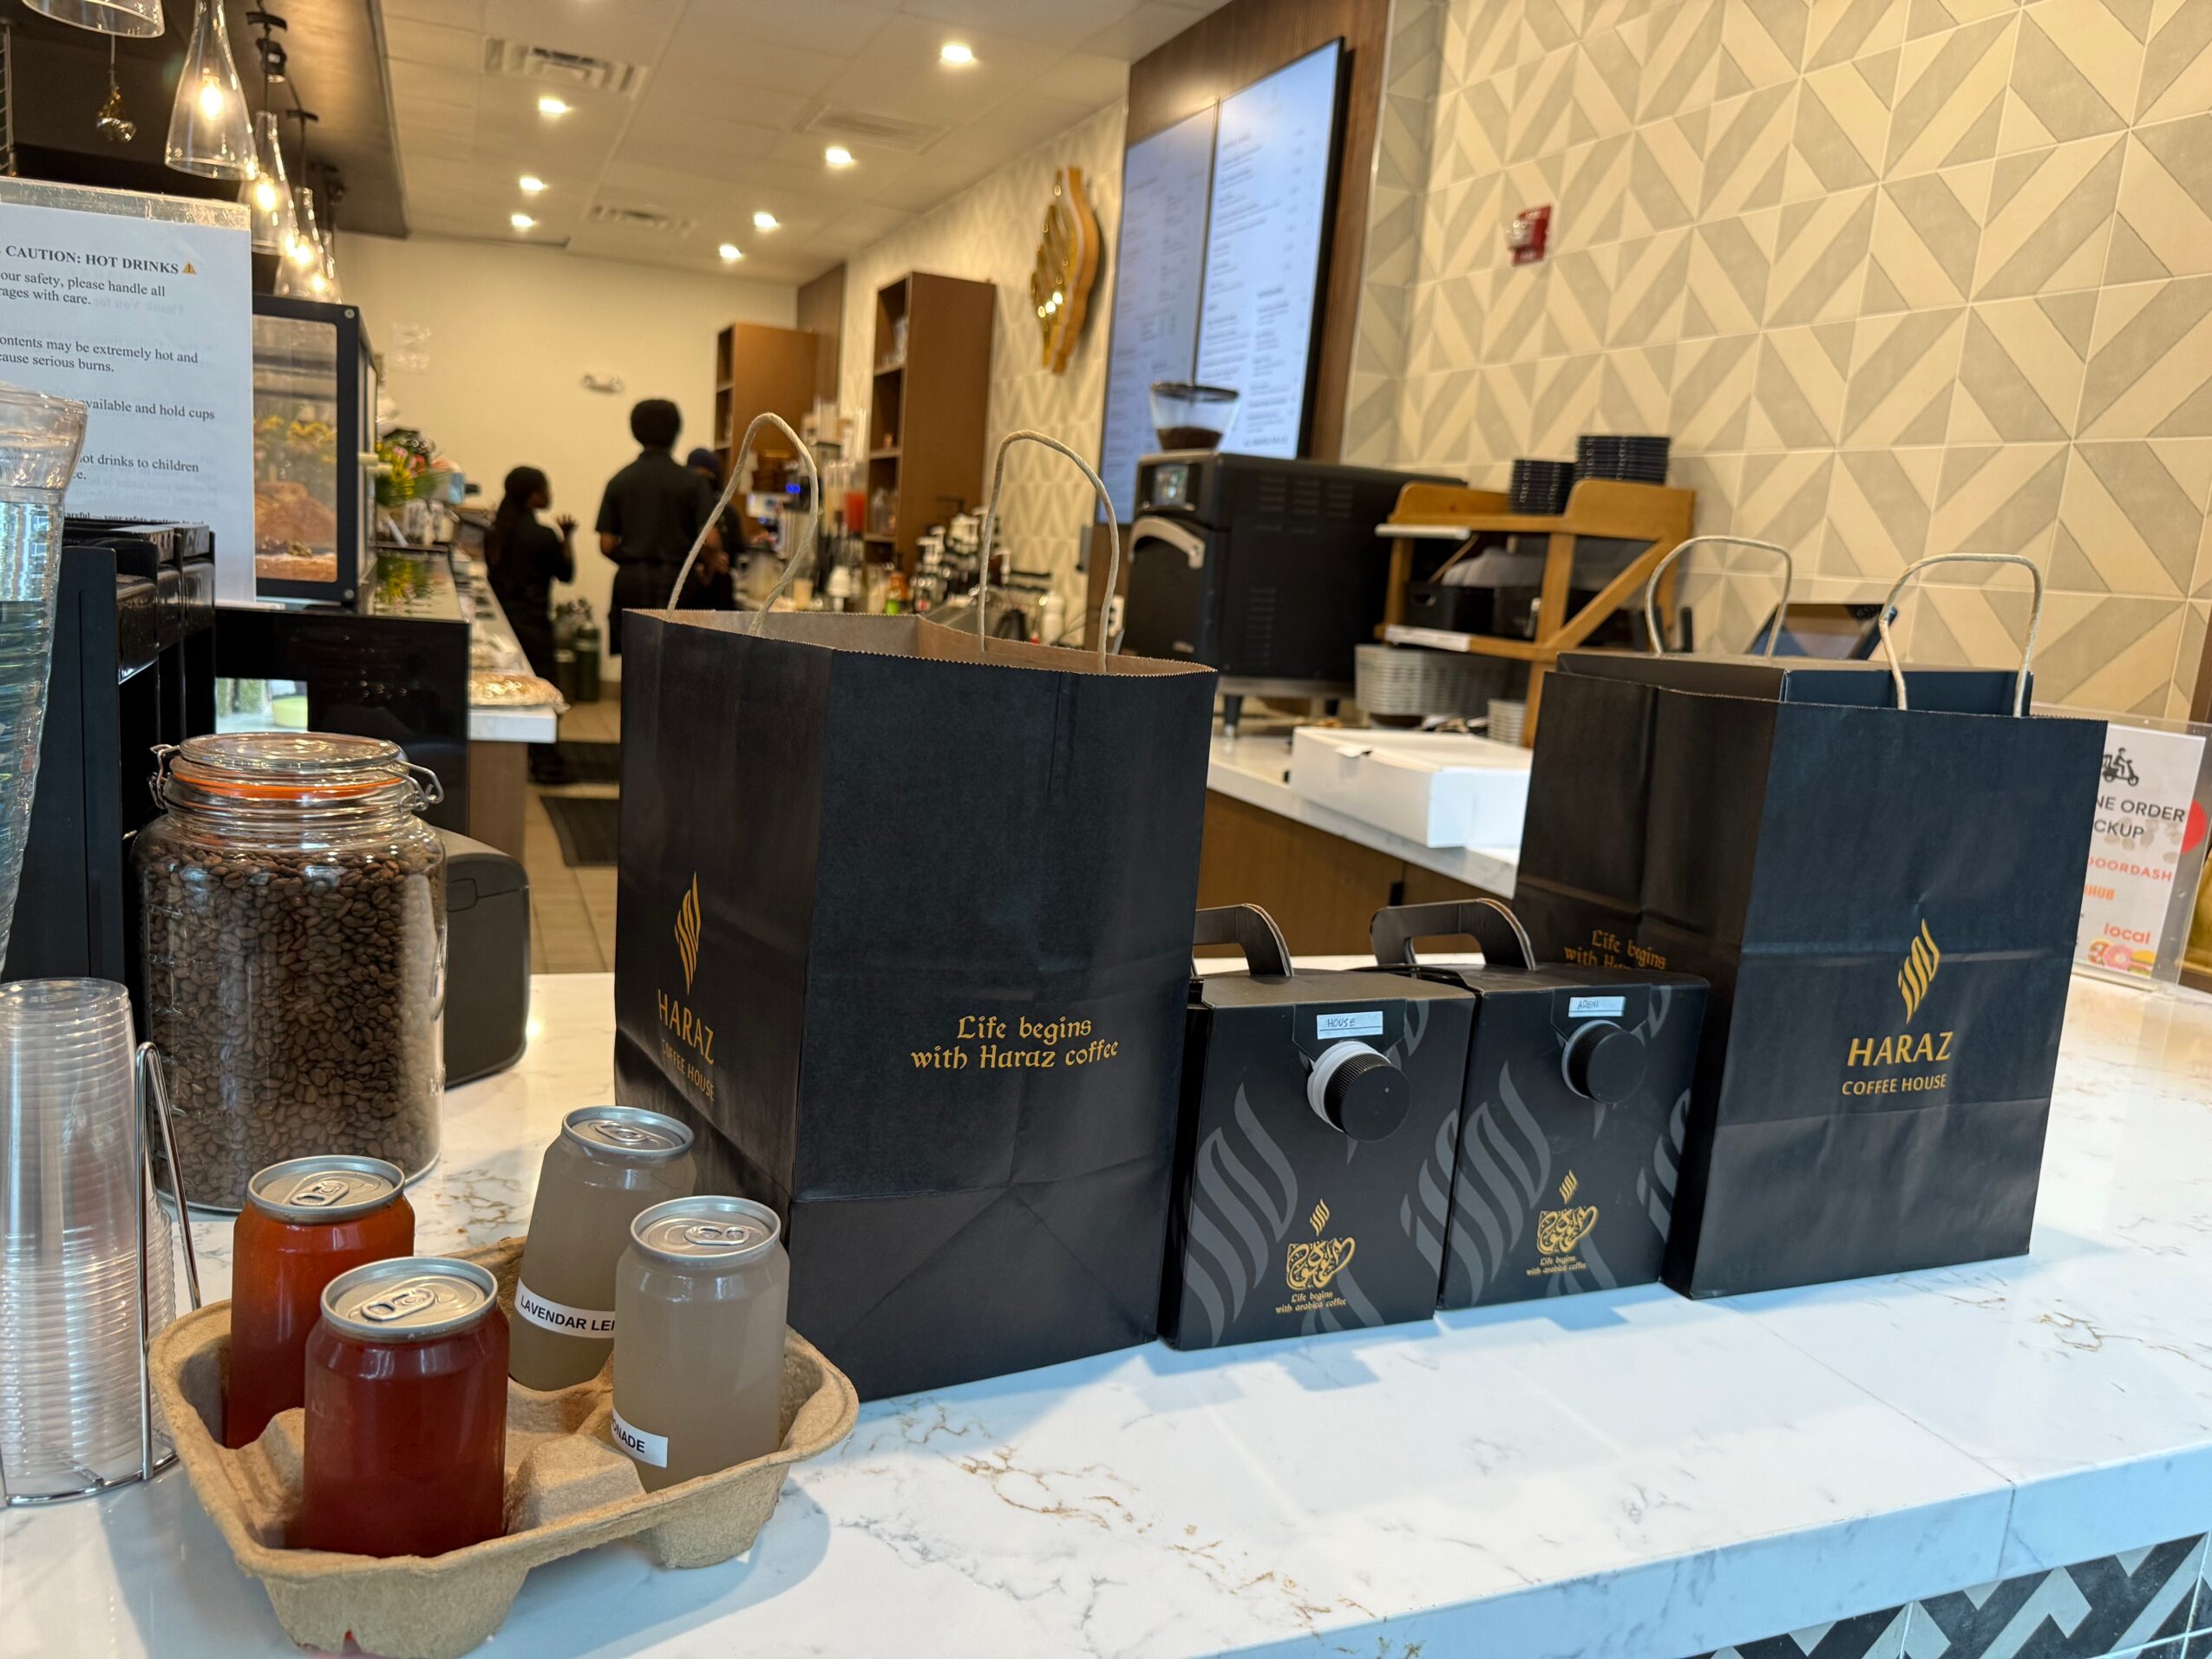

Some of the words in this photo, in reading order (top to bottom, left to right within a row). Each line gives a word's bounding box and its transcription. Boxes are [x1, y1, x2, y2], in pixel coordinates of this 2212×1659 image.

[5, 245, 82, 264] CAUTION:
[86, 254, 118, 268] HOT
[122, 258, 179, 274] DRINKS
[0, 271, 22, 281] our
[24, 272, 64, 288] safety,
[68, 277, 104, 291] please
[108, 280, 147, 295] handle
[151, 285, 166, 297] all
[33, 289, 59, 302] with
[62, 294, 91, 304] care.
[0, 336, 43, 348] ontents
[46, 342, 72, 353] may
[75, 341, 89, 353] be
[93, 344, 152, 361] extremely
[155, 349, 174, 362] hot
[177, 353, 199, 363] and
[32, 356, 75, 369] serious
[78, 358, 115, 372] burns.
[135, 403, 156, 415] and
[160, 404, 185, 417] hold
[189, 408, 215, 421] cups
[98, 454, 134, 467] drinks
[137, 460, 148, 468] to
[152, 458, 199, 473] children
[2120, 799, 2185, 822] ORDER
[2093, 819, 2144, 839] CKUP
[2103, 923, 2150, 944] local
[1564, 946, 1598, 967] with
[1591, 929, 1621, 953] Life
[1626, 939, 1666, 970] begins
[658, 988, 714, 1065] HARAZ
[957, 1015, 1007, 1039] Life
[1019, 1016, 1092, 1045] begins
[1327, 1018, 1355, 1028] HOUSE
[911, 1045, 968, 1069] with
[980, 1044, 1056, 1068] Haraz
[1064, 1039, 1119, 1066] coffee
[1847, 1031, 1953, 1067] HARAZ
[662, 1039, 686, 1077] COFFEE
[688, 1063, 715, 1101] HOUSE
[1842, 1078, 1898, 1096] COFFEE
[1901, 1073, 1947, 1092] HOUSE
[520, 1294, 587, 1330] LAVENDAR
[611, 1417, 645, 1453] ONADE
